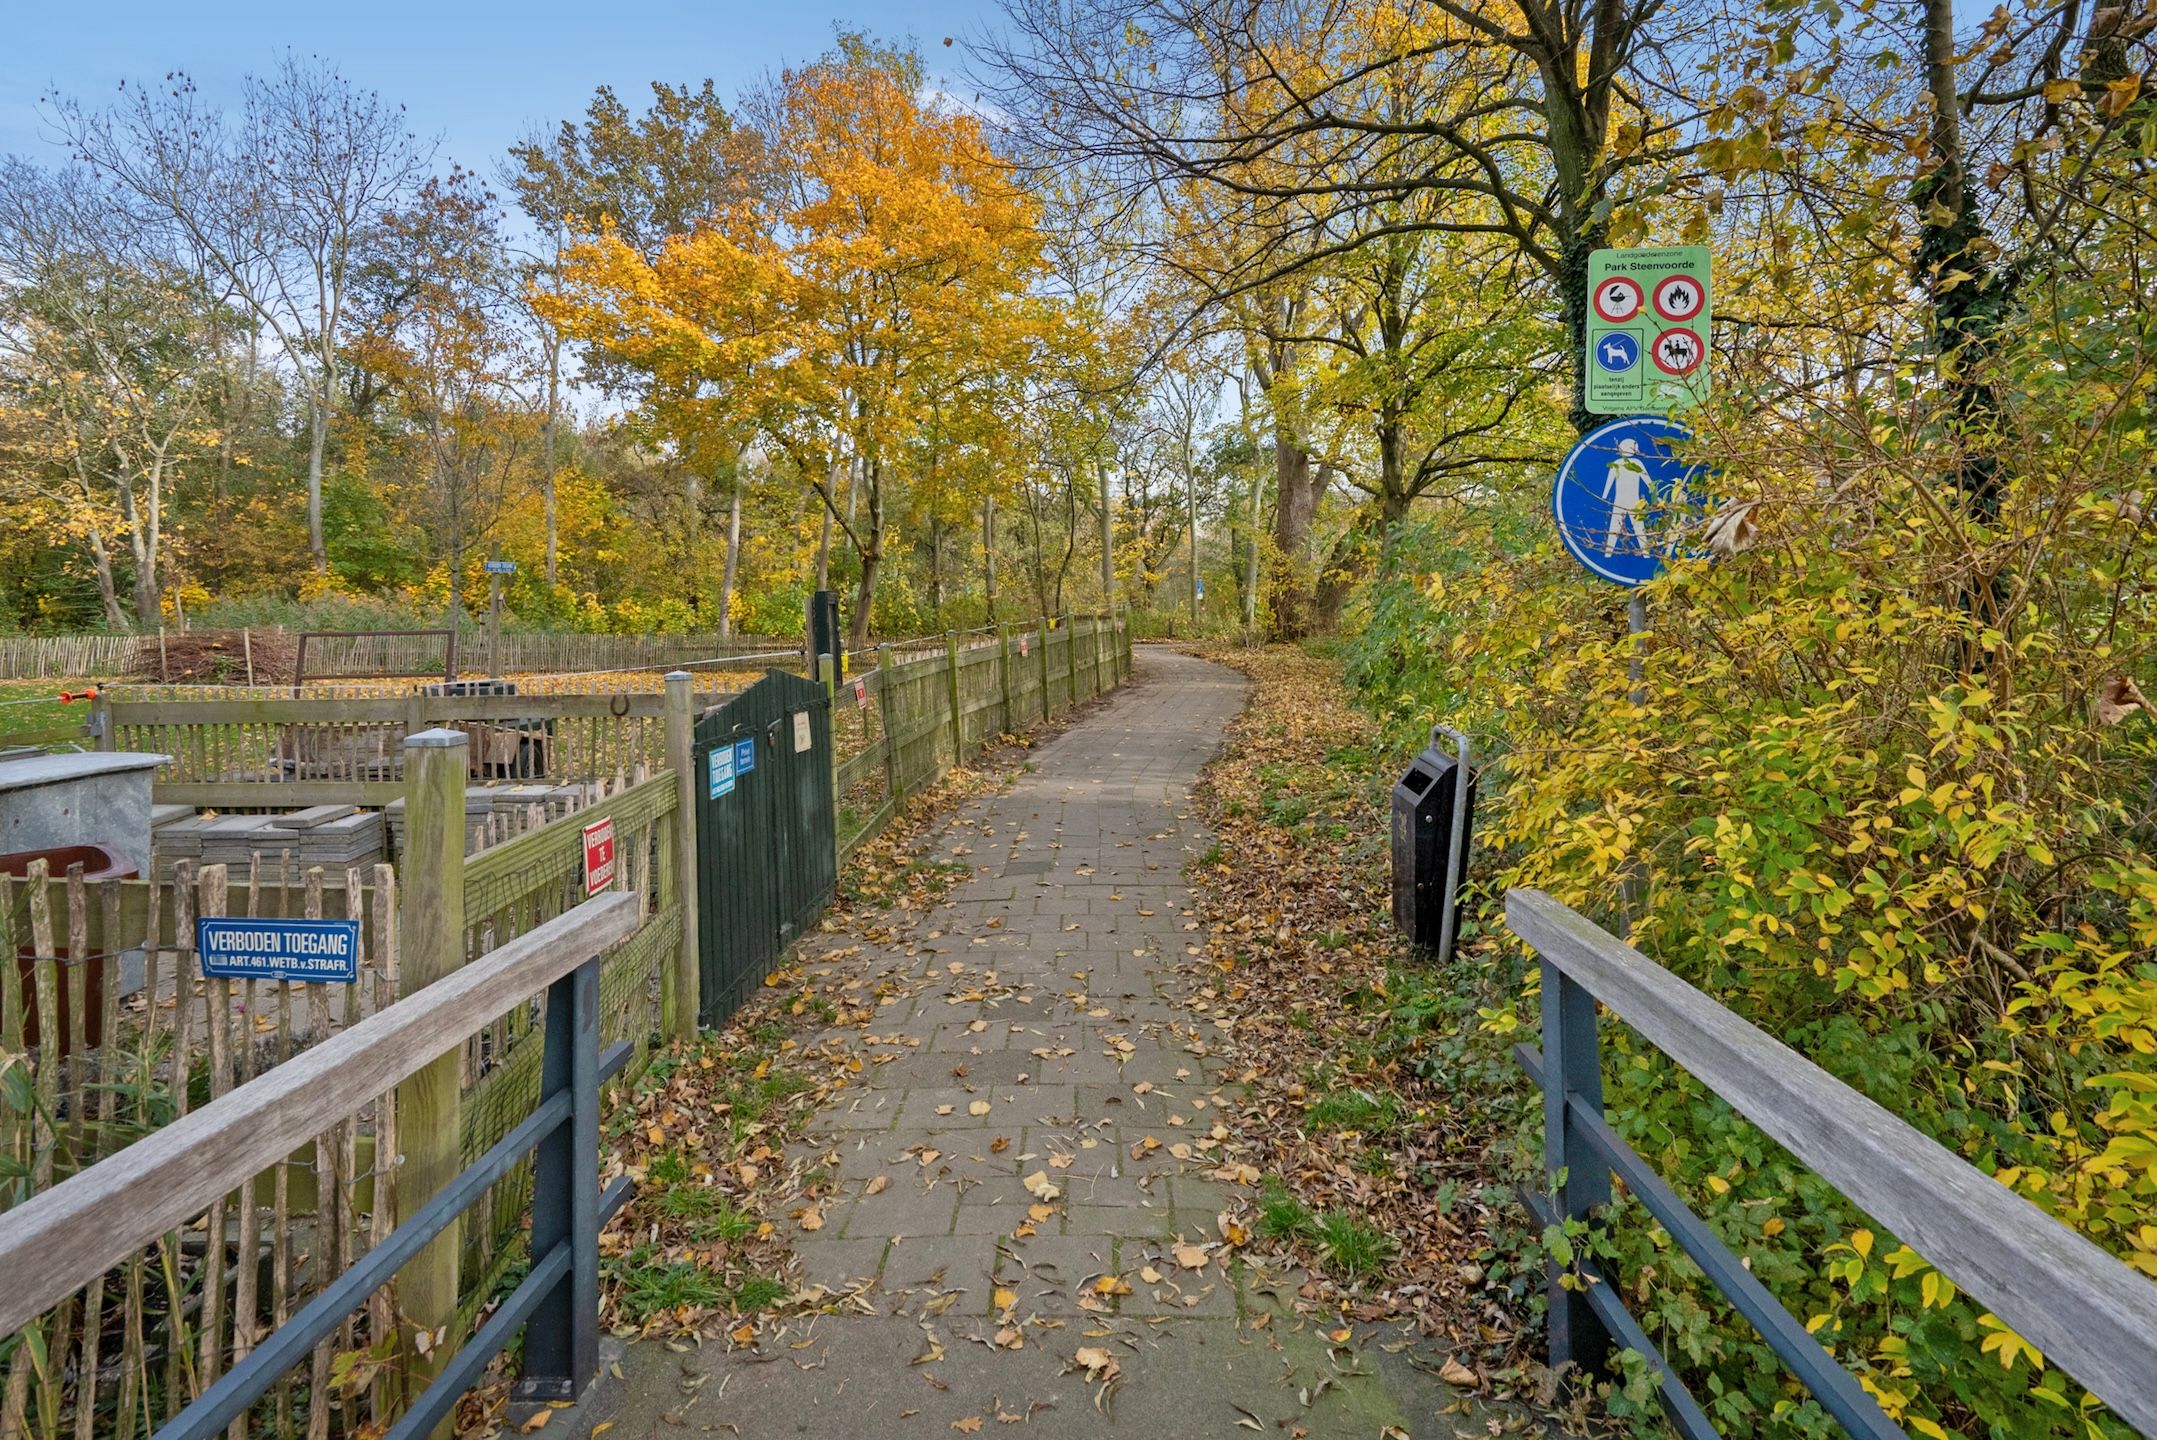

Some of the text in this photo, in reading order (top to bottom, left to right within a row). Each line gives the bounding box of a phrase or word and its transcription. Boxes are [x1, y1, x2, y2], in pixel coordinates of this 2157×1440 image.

[1605, 261, 1695, 271] Park Steenvoorde
[711, 749, 732, 769] VERBODEN
[587, 824, 613, 849] VERBODEN
[599, 845, 606, 862] TE
[208, 931, 348, 955] VERBODEN TOEGANG
